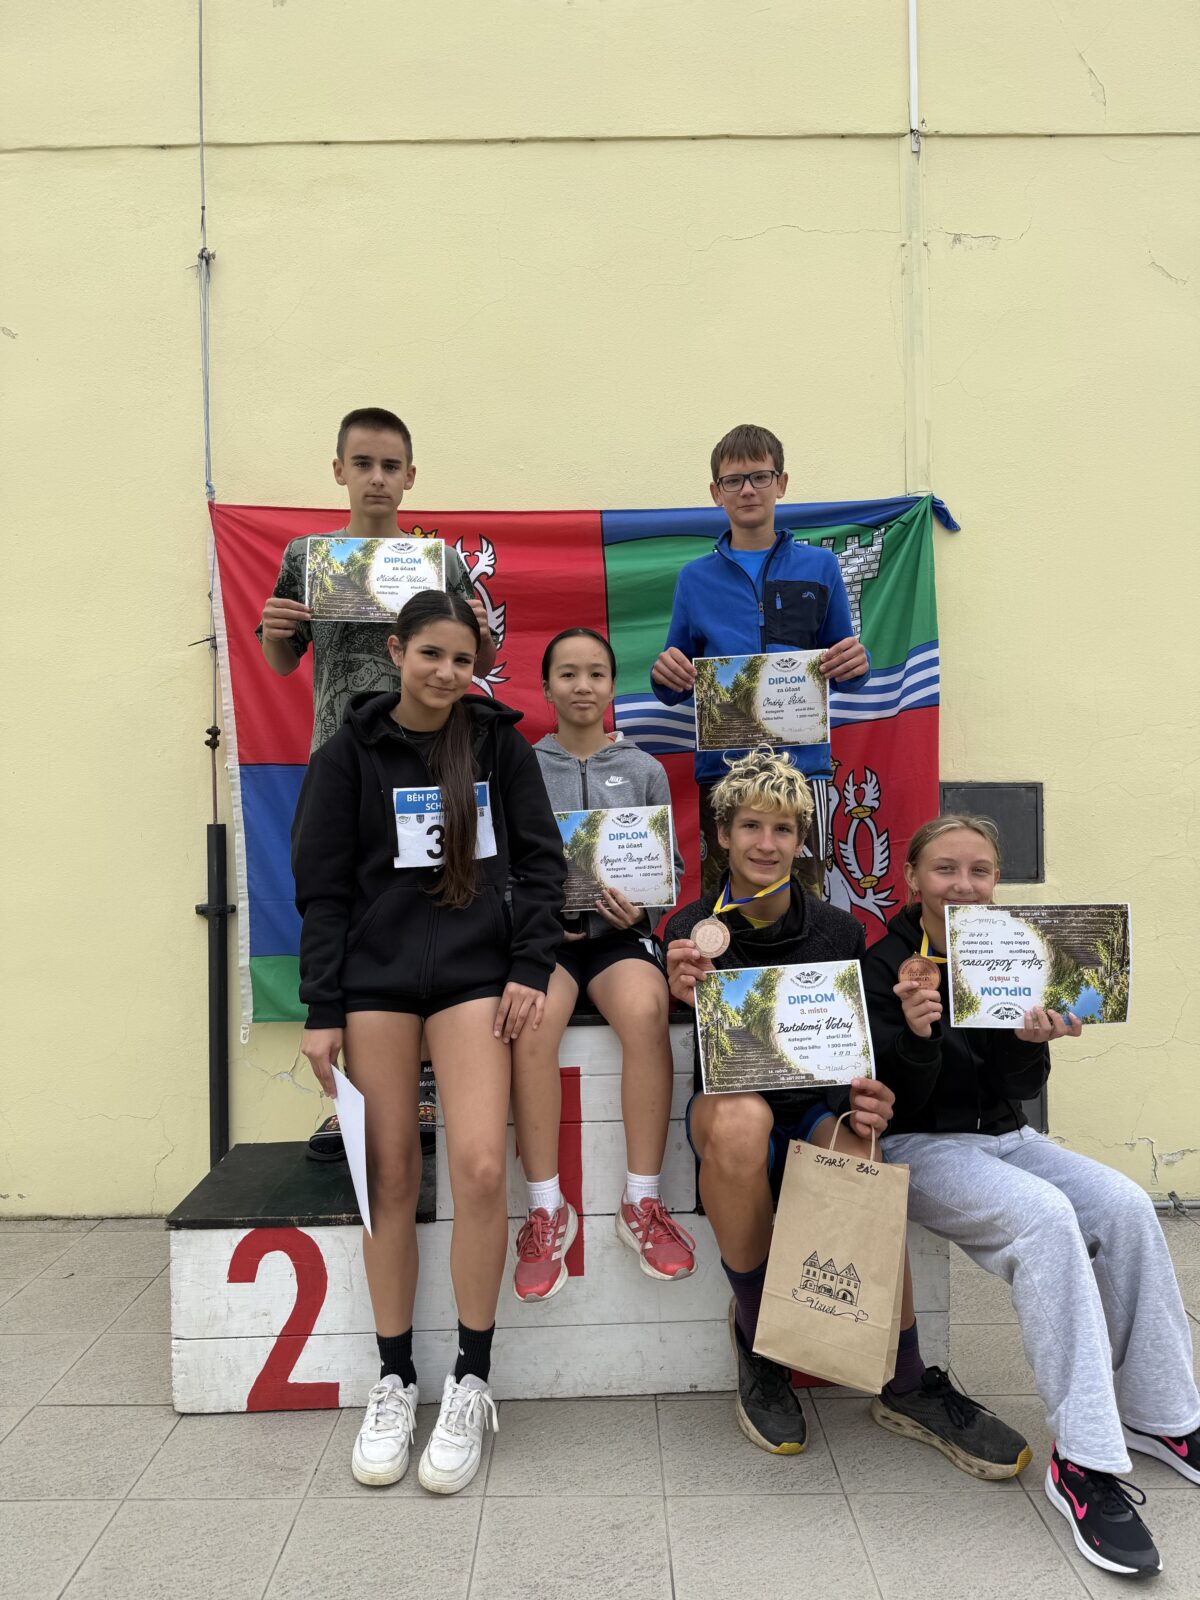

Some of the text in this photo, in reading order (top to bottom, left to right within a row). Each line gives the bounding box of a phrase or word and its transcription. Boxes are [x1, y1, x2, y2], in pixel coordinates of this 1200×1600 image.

[384, 556, 422, 564] DIPLOM
[768, 675, 806, 685] DIPLOM
[406, 793, 425, 802] BĚH
[426, 824, 445, 860] 3
[608, 831, 648, 841] DIPLOM
[1021, 954, 1046, 970] Sofie
[980, 986, 1032, 996] DIPLOM
[788, 993, 835, 1005] DIPLOM
[778, 1014, 855, 1035] Bartoloměj Volný
[794, 1145, 879, 1176] 3. STARŠÍ ŽÁCI
[227, 1227, 340, 1411] 2
